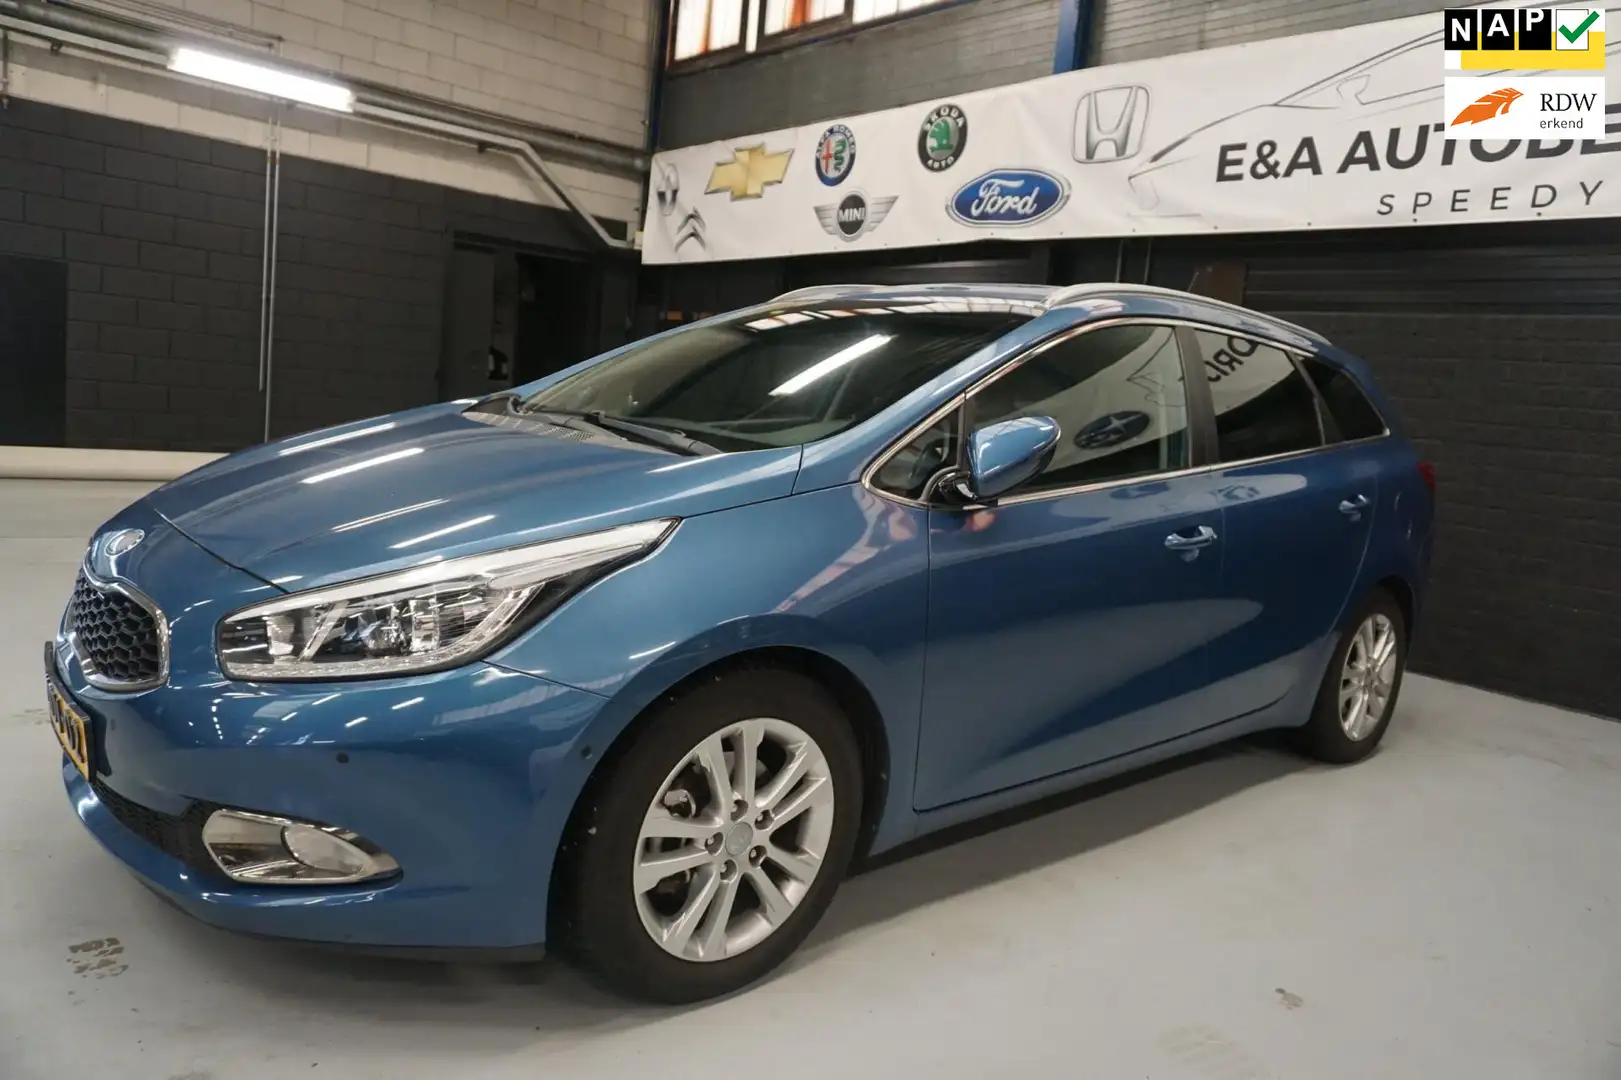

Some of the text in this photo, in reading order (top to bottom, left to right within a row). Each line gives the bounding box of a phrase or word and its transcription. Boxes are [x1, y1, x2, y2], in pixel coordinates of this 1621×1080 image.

[1216, 136, 1323, 182] E&A
[838, 206, 866, 222] MINI
[971, 178, 1040, 217] Ford
[1377, 180, 1603, 215] SPEEDY
